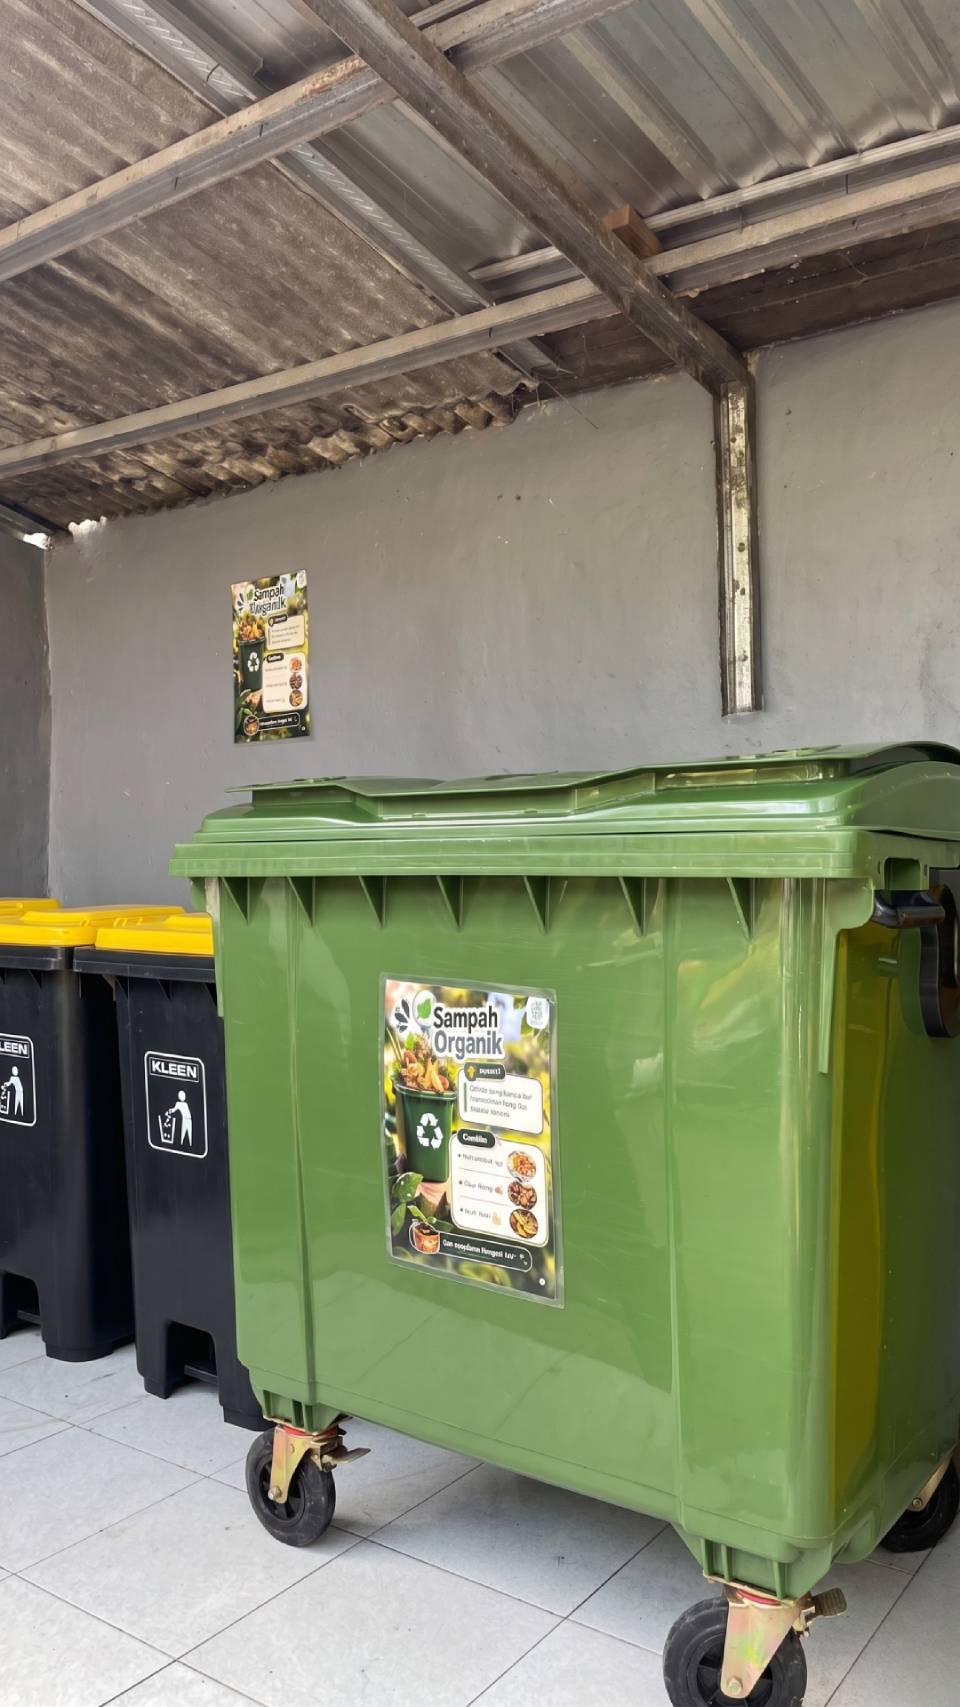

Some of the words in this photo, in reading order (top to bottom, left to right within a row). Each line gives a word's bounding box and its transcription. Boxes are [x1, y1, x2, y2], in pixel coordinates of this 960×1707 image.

[253, 583, 285, 602] Sampah
[433, 1005, 498, 1034] Sampah
[0, 1040, 28, 1055] LEEN
[434, 1030, 503, 1060] Organik
[151, 1059, 197, 1079] KLEEN
